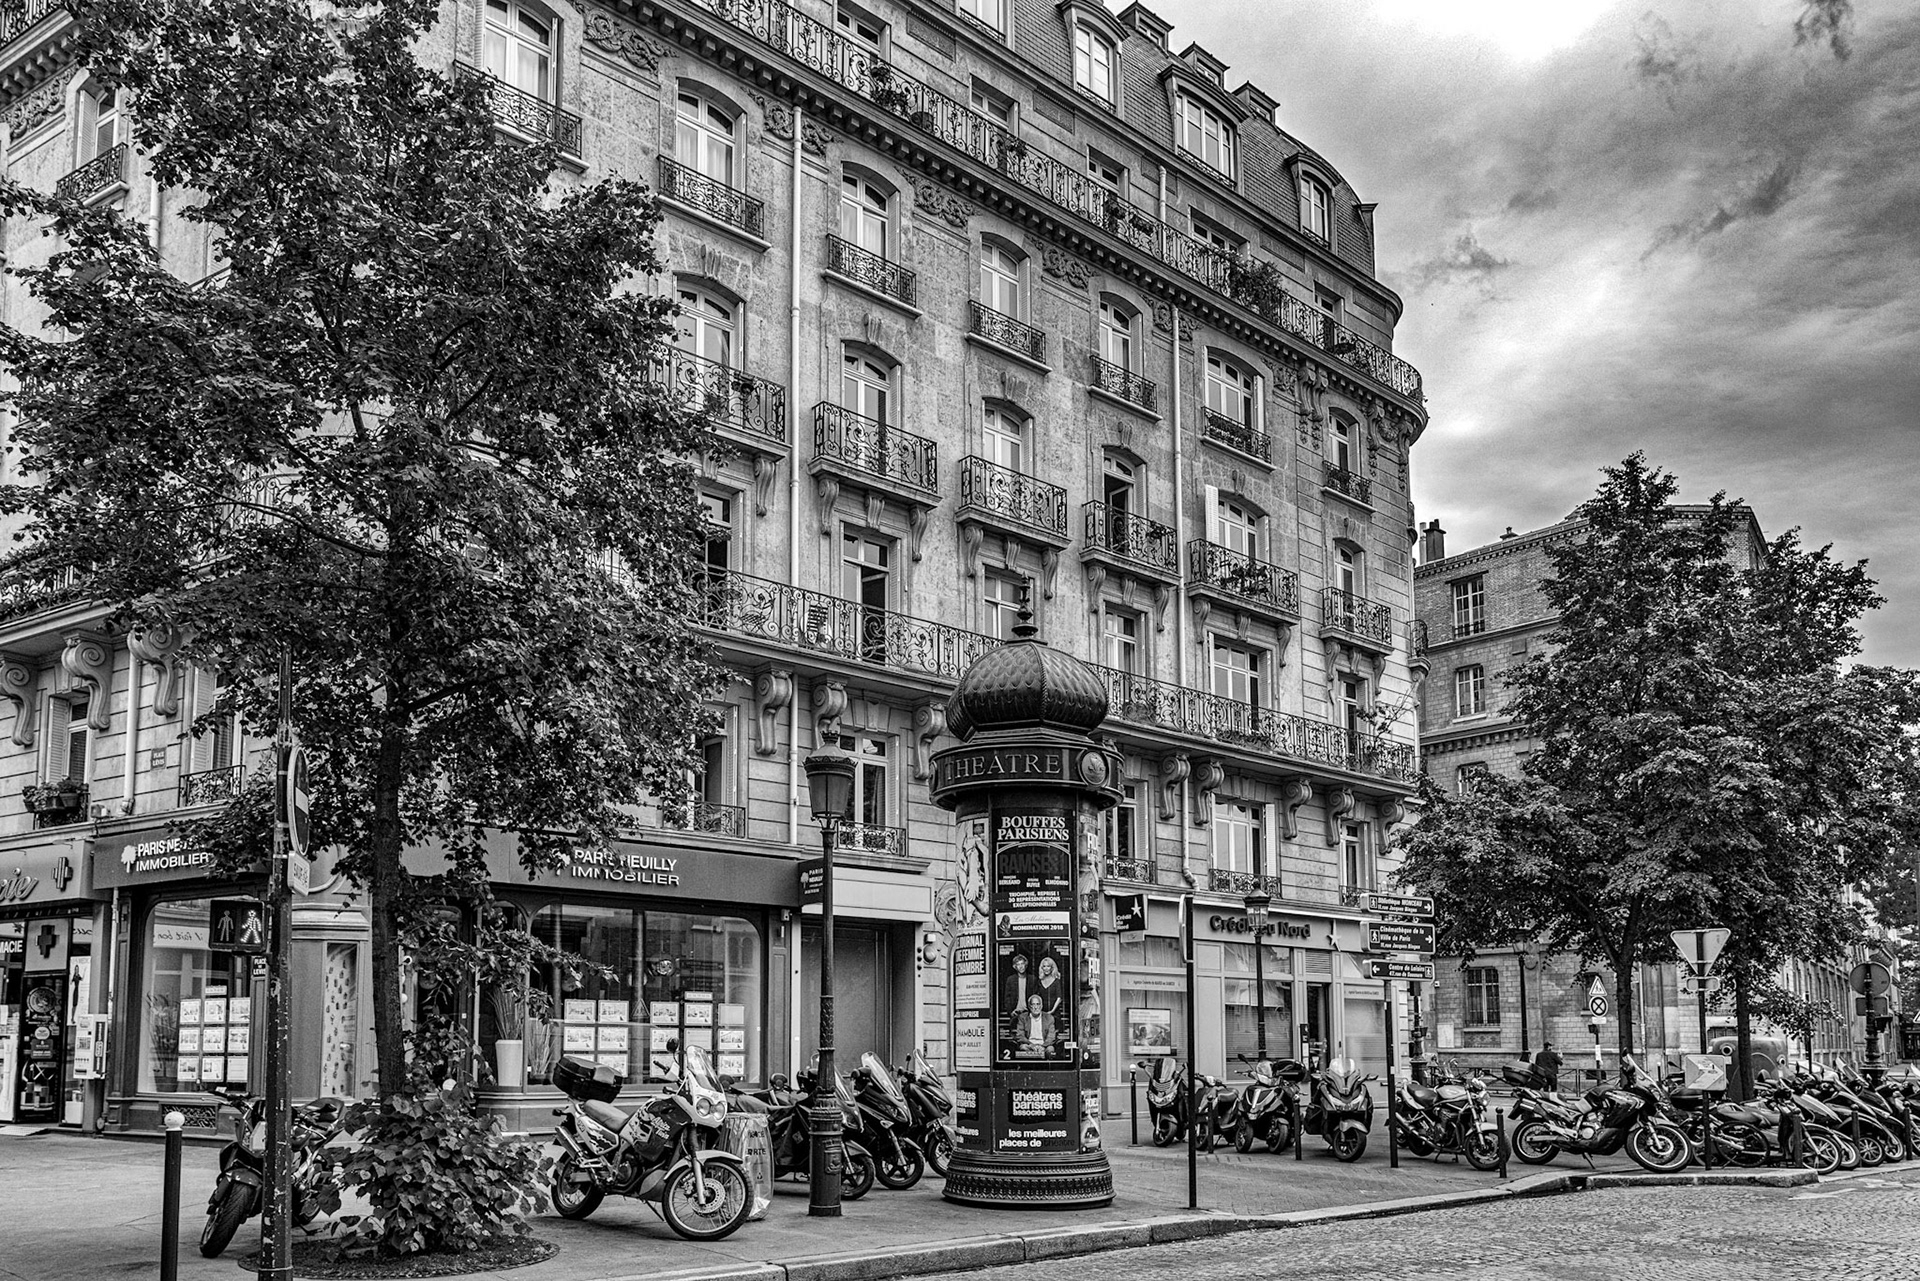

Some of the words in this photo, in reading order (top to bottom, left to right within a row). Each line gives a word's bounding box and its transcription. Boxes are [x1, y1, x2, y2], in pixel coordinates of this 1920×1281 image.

[1001, 816, 1066, 829] BOUFFES
[997, 828, 1069, 841] PARISIENS
[137, 841, 165, 857] PARIS
[136, 852, 209, 872] IMMOBILIER
[574, 850, 615, 866] PARS
[1278, 920, 1312, 939] Nord
[1003, 1049, 1011, 1060] 2
[1012, 1091, 1063, 1102] théâtres
[1012, 1101, 1063, 1112] parisiens
[1008, 1129, 1022, 1138] les
[1023, 1129, 1067, 1138] meilleures
[999, 1138, 1028, 1149] places
[1029, 1139, 1042, 1147] de
